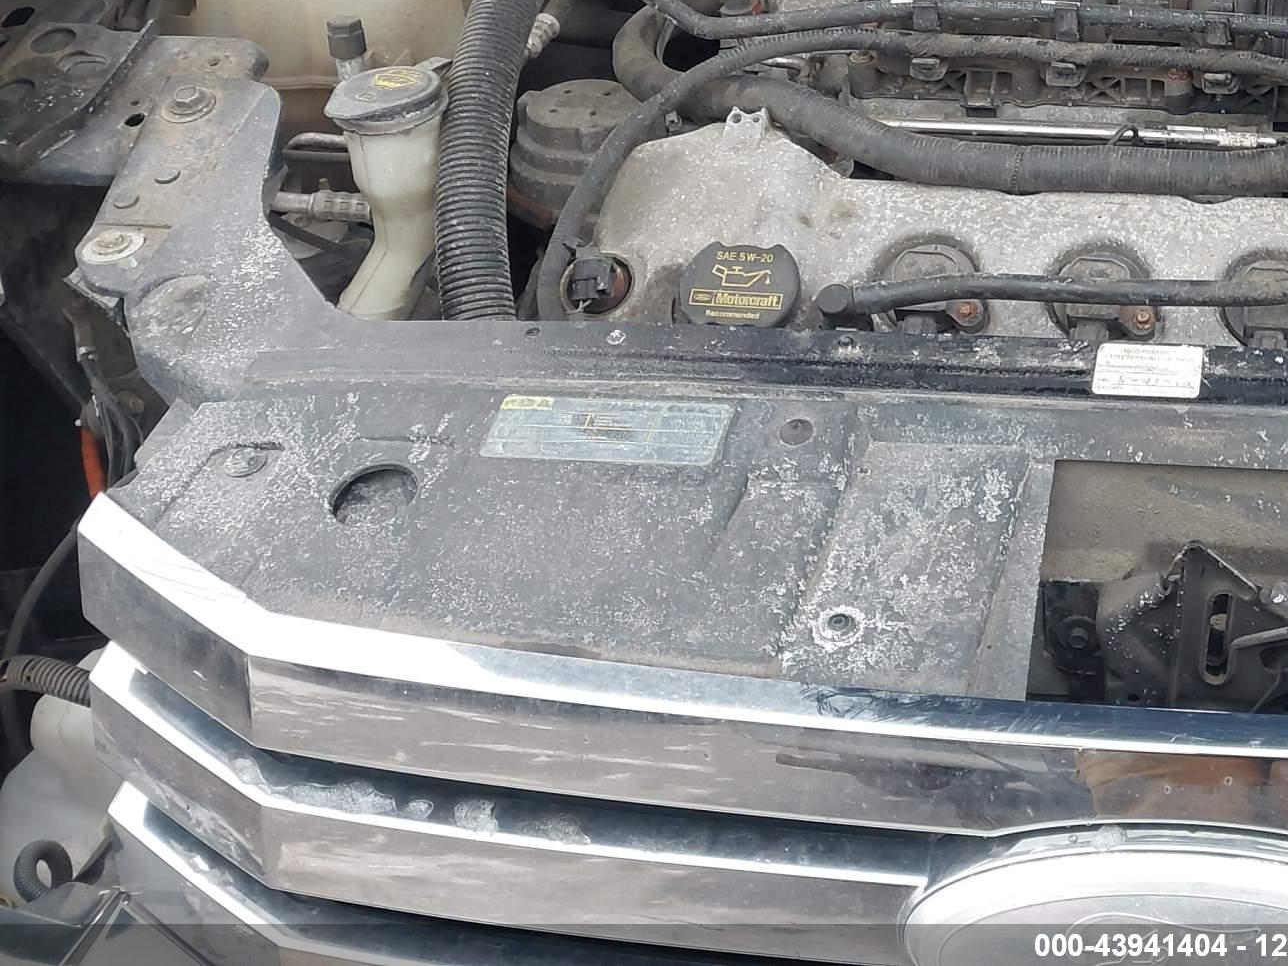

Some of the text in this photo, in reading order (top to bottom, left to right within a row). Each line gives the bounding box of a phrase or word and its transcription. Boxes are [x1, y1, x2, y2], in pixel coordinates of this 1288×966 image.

[716, 251, 774, 263] SAE 5W-20
[715, 292, 779, 308] Motorcraft
[705, 309, 760, 320] Recommended
